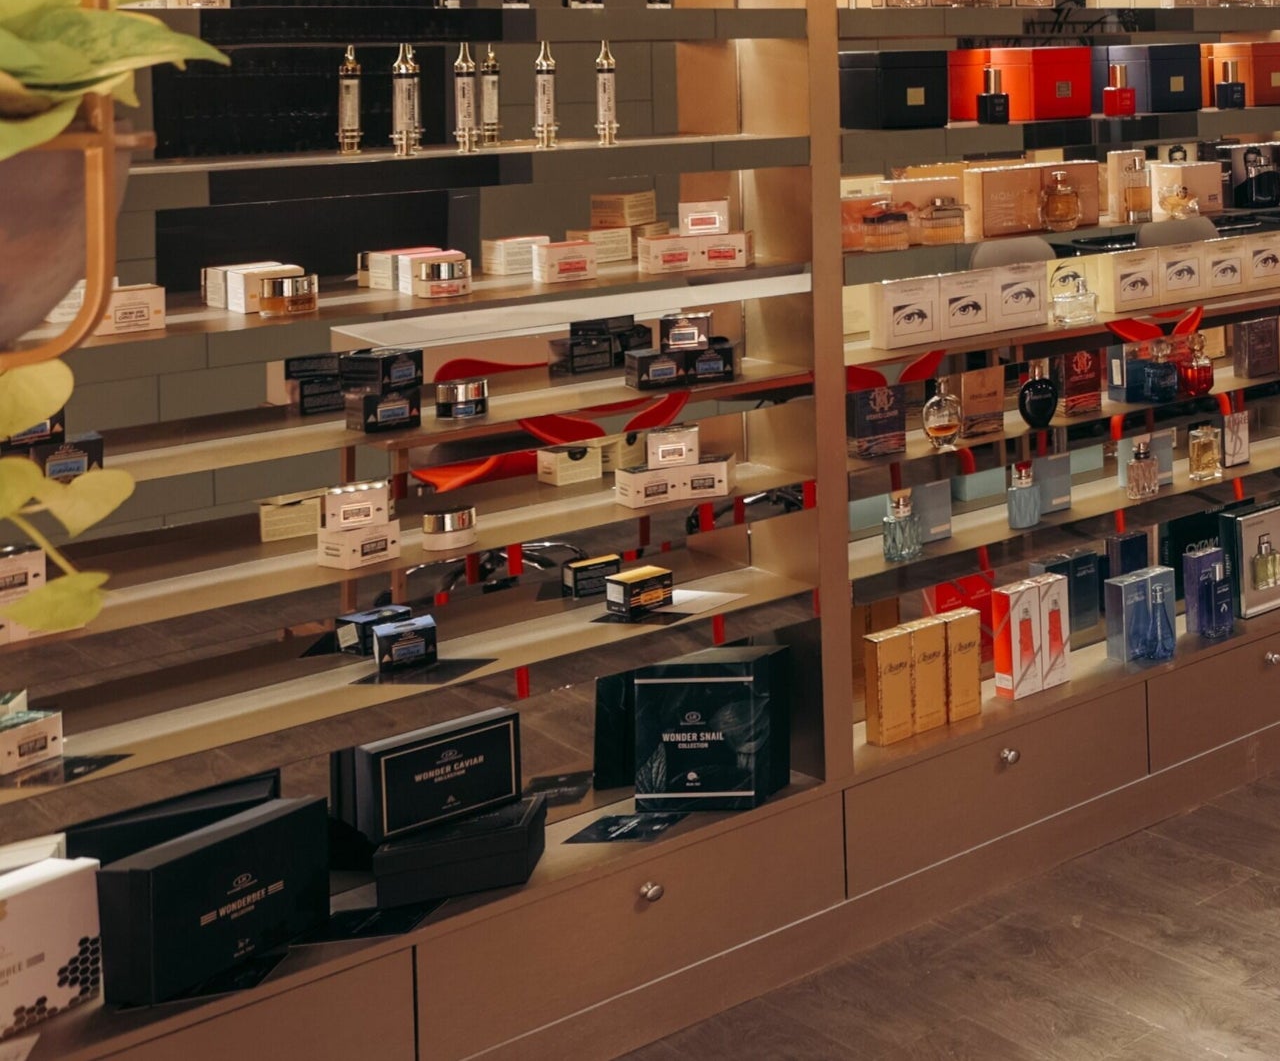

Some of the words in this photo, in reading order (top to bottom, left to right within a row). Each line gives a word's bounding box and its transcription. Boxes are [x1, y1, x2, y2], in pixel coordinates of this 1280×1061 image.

[662, 732, 698, 742] WONDER
[699, 731, 725, 741] SNAIL
[414, 765, 452, 783] WONDER
[453, 754, 485, 771] CAVIAR
